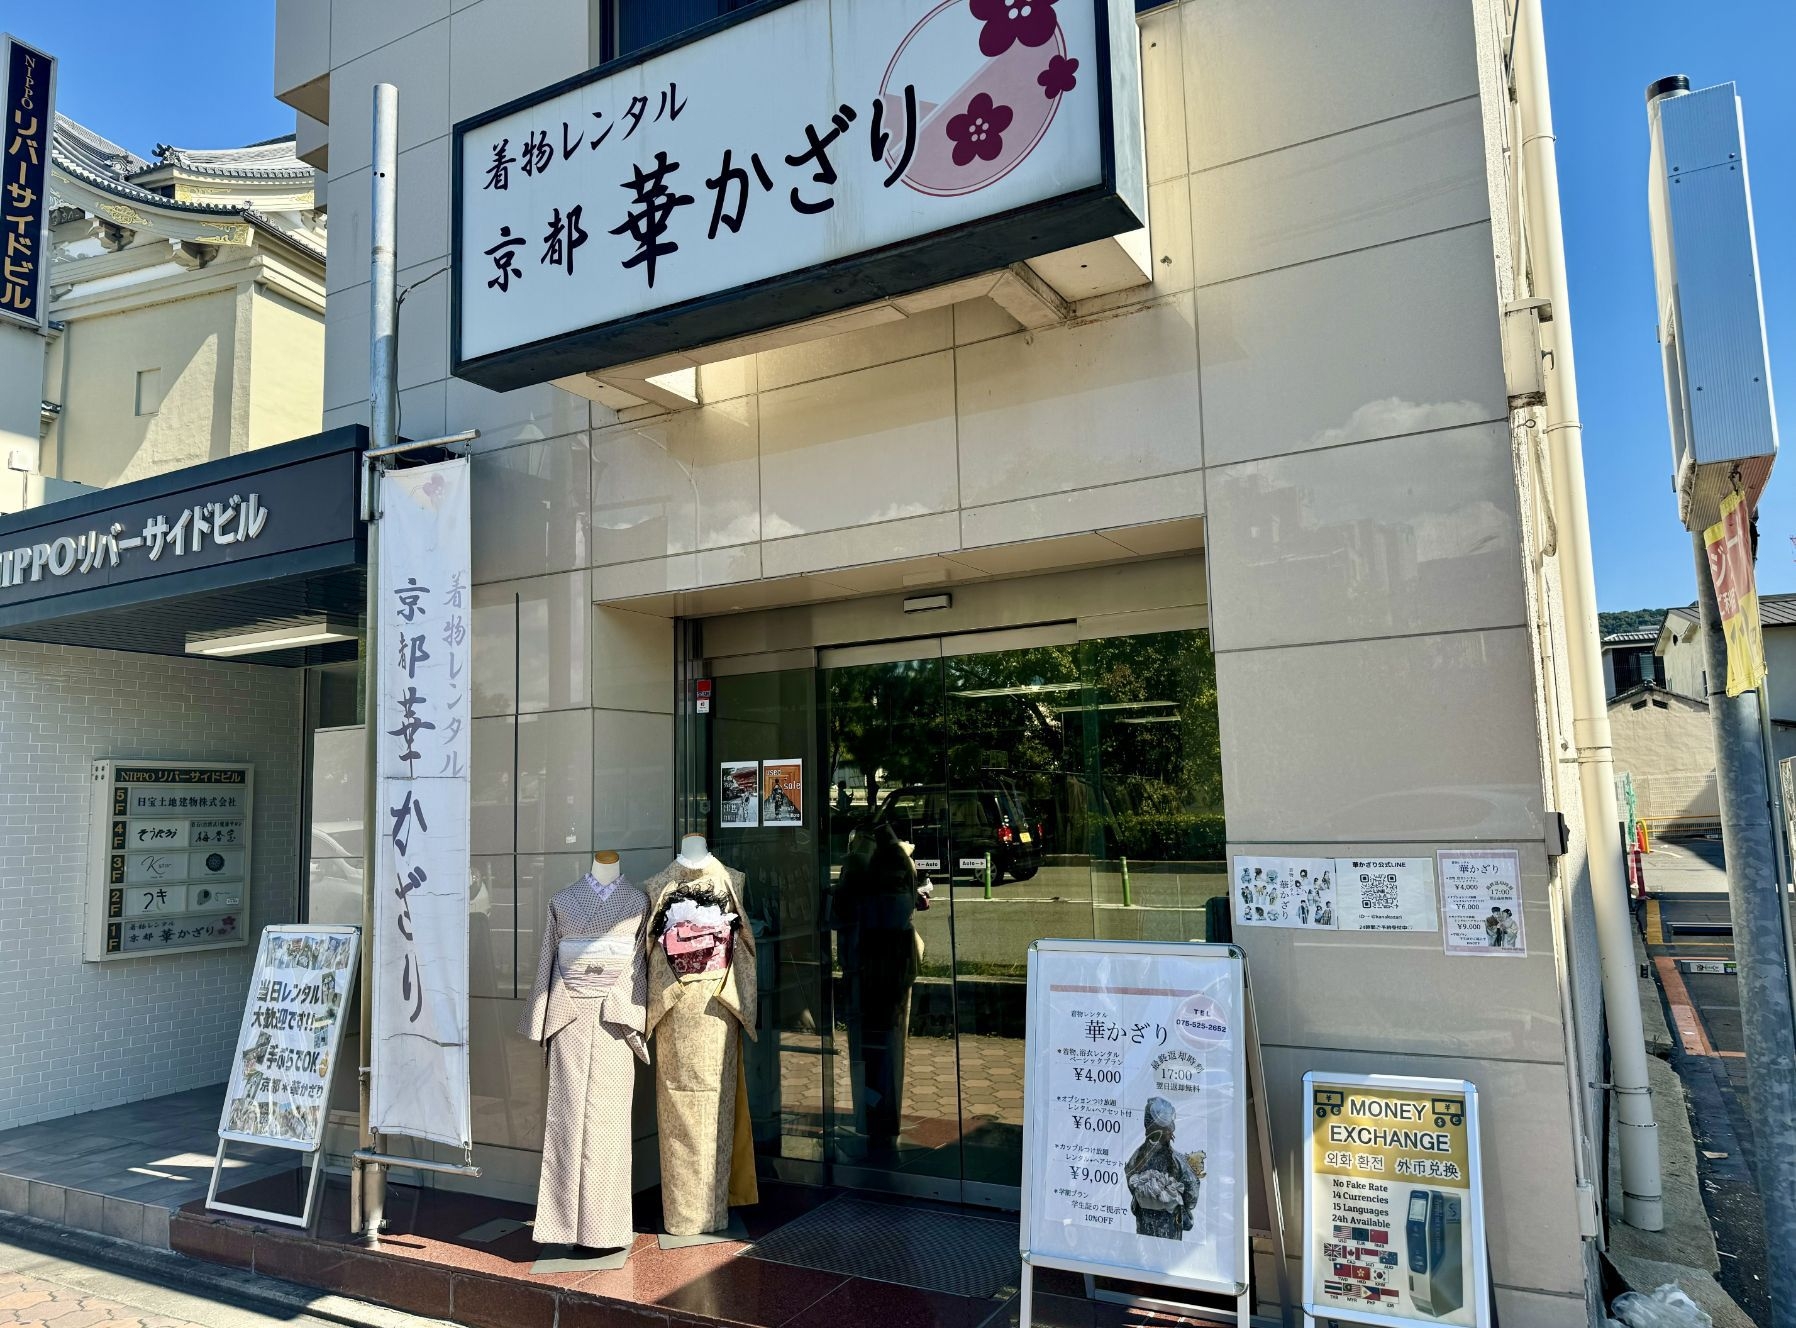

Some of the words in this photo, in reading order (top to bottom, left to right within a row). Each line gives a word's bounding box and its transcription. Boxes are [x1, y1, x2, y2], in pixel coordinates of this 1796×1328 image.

[483, 82, 688, 191] 着物レンタル
[0, 493, 268, 588] IPPOリバーサイドビル
[440, 572, 467, 777] 着物レンタル
[137, 796, 237, 808] 日宝土地建物株式会社
[1459, 864, 1499, 874] 華かざり
[257, 979, 321, 1005] 当日レンタル
[1193, 1008, 1211, 1017] TEL
[1084, 1019, 1168, 1047] 華かざり
[1176, 1019, 1227, 1033] 075-525-2652
[1073, 1067, 1121, 1084] ¥4,000
[1161, 1068, 1192, 1081] 17:00
[1350, 1099, 1427, 1121] MONEY
[1072, 1115, 1121, 1134] ¥6,000
[1330, 1125, 1450, 1153] EXCHANGE
[1327, 1152, 1353, 1168] 외화
[1357, 1155, 1384, 1171] 환전
[1397, 1160, 1459, 1179] 外币兑换
[1069, 1165, 1119, 1185] ¥9,000
[1333, 1179, 1344, 1188] No
[1346, 1181, 1367, 1190] Fake
[1369, 1183, 1388, 1193] Rate
[1333, 1191, 1341, 1199] 14
[1343, 1192, 1389, 1205] Currencies
[1333, 1203, 1341, 1211] 15
[1343, 1204, 1389, 1217] Languages
[1084, 1214, 1114, 1225] 10%OFF
[1332, 1214, 1348, 1224] 24h
[1350, 1216, 1391, 1229] Available
